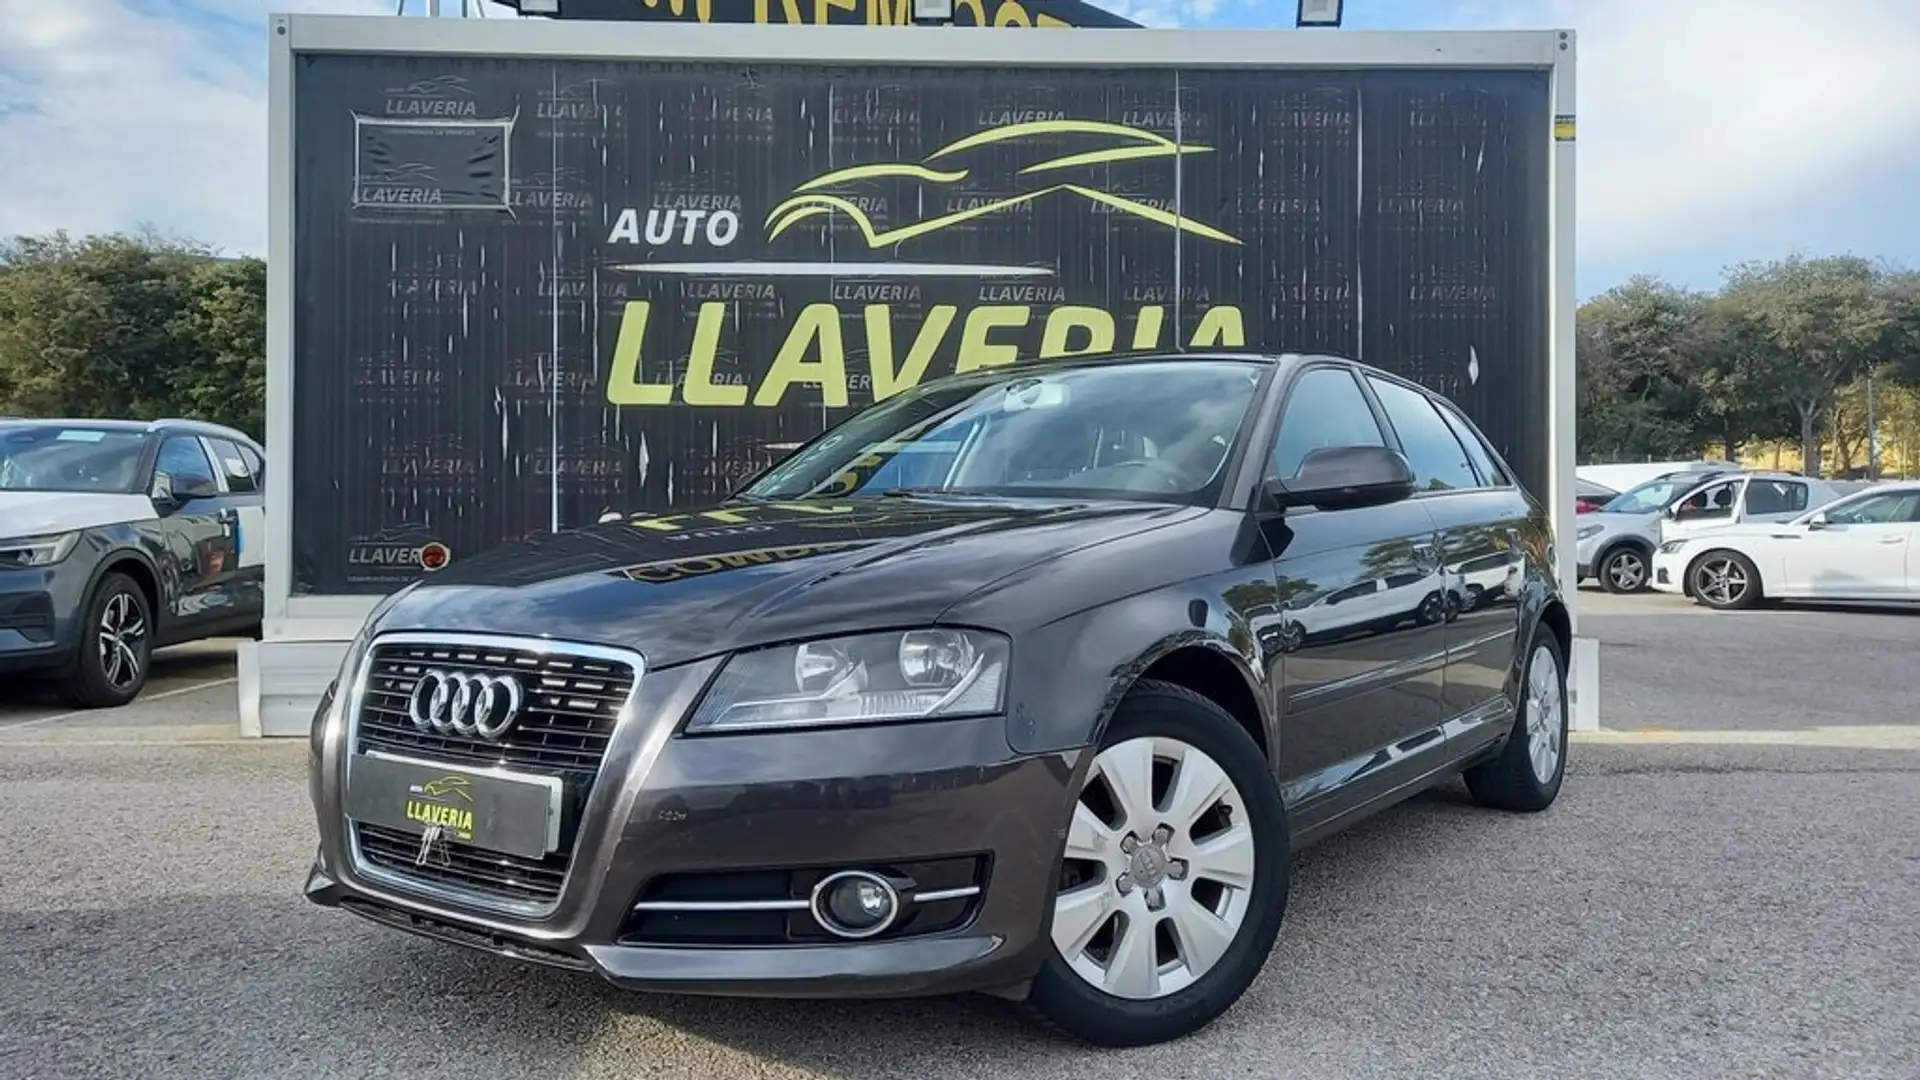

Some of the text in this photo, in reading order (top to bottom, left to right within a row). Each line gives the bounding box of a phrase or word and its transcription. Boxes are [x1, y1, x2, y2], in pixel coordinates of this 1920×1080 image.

[386, 100, 476, 116] LLAVERIA
[537, 103, 626, 118] LLAVE
[979, 110, 1066, 126] LLAVERIA
[1122, 111, 1210, 127] LLAVEIA
[354, 187, 443, 204] LAVERIA
[653, 194, 742, 209] LLAVERIA
[1090, 198, 1177, 214] LLERIA
[607, 208, 739, 246] AUTO
[538, 281, 627, 297] LLAVIA
[688, 283, 775, 298] LLAVERIA
[835, 285, 921, 300] LLAVERIA
[979, 286, 1066, 302] LLAVERIA
[505, 371, 596, 387] LLAERIA
[349, 547, 421, 564] LLAVER
[407, 800, 472, 830] LLAVERIA
